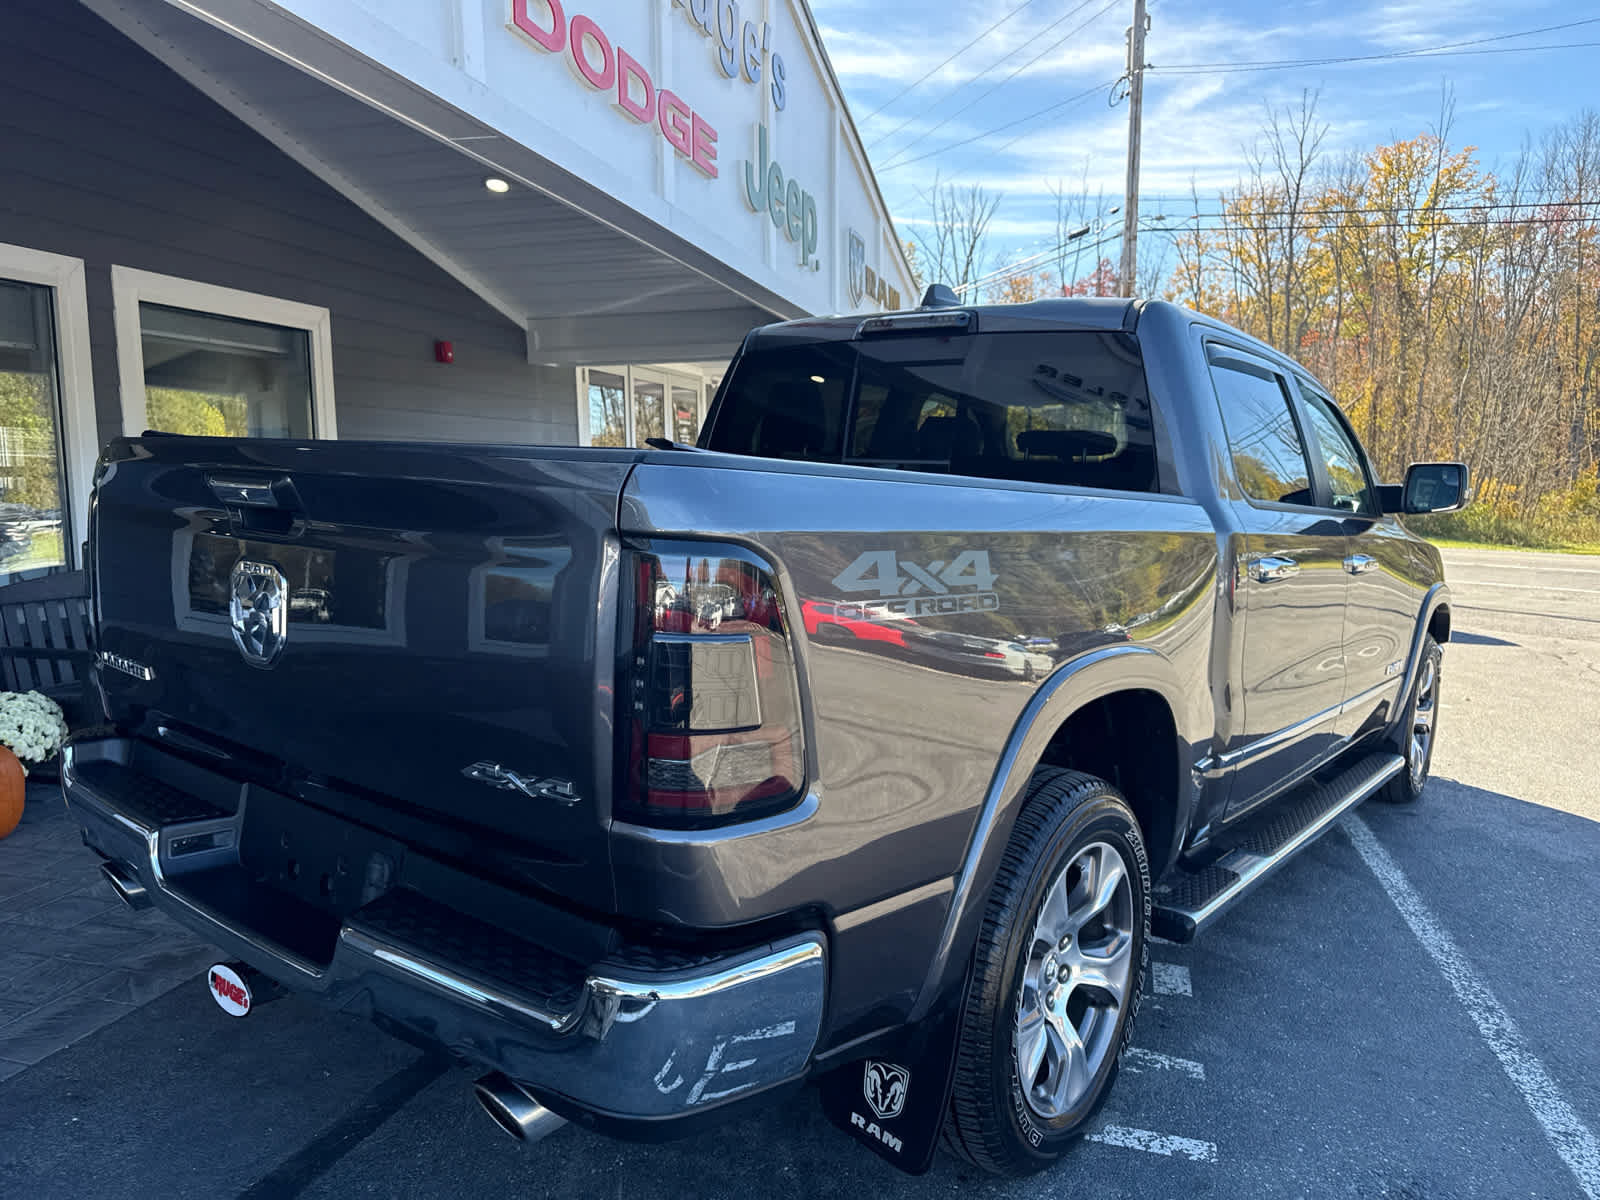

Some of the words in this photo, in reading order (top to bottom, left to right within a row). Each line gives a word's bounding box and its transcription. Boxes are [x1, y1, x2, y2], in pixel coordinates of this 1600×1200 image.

[512, 0, 718, 179] DODGE
[865, 265, 900, 311] RAM
[240, 561, 276, 577] RAM
[851, 1111, 903, 1153] RAM
